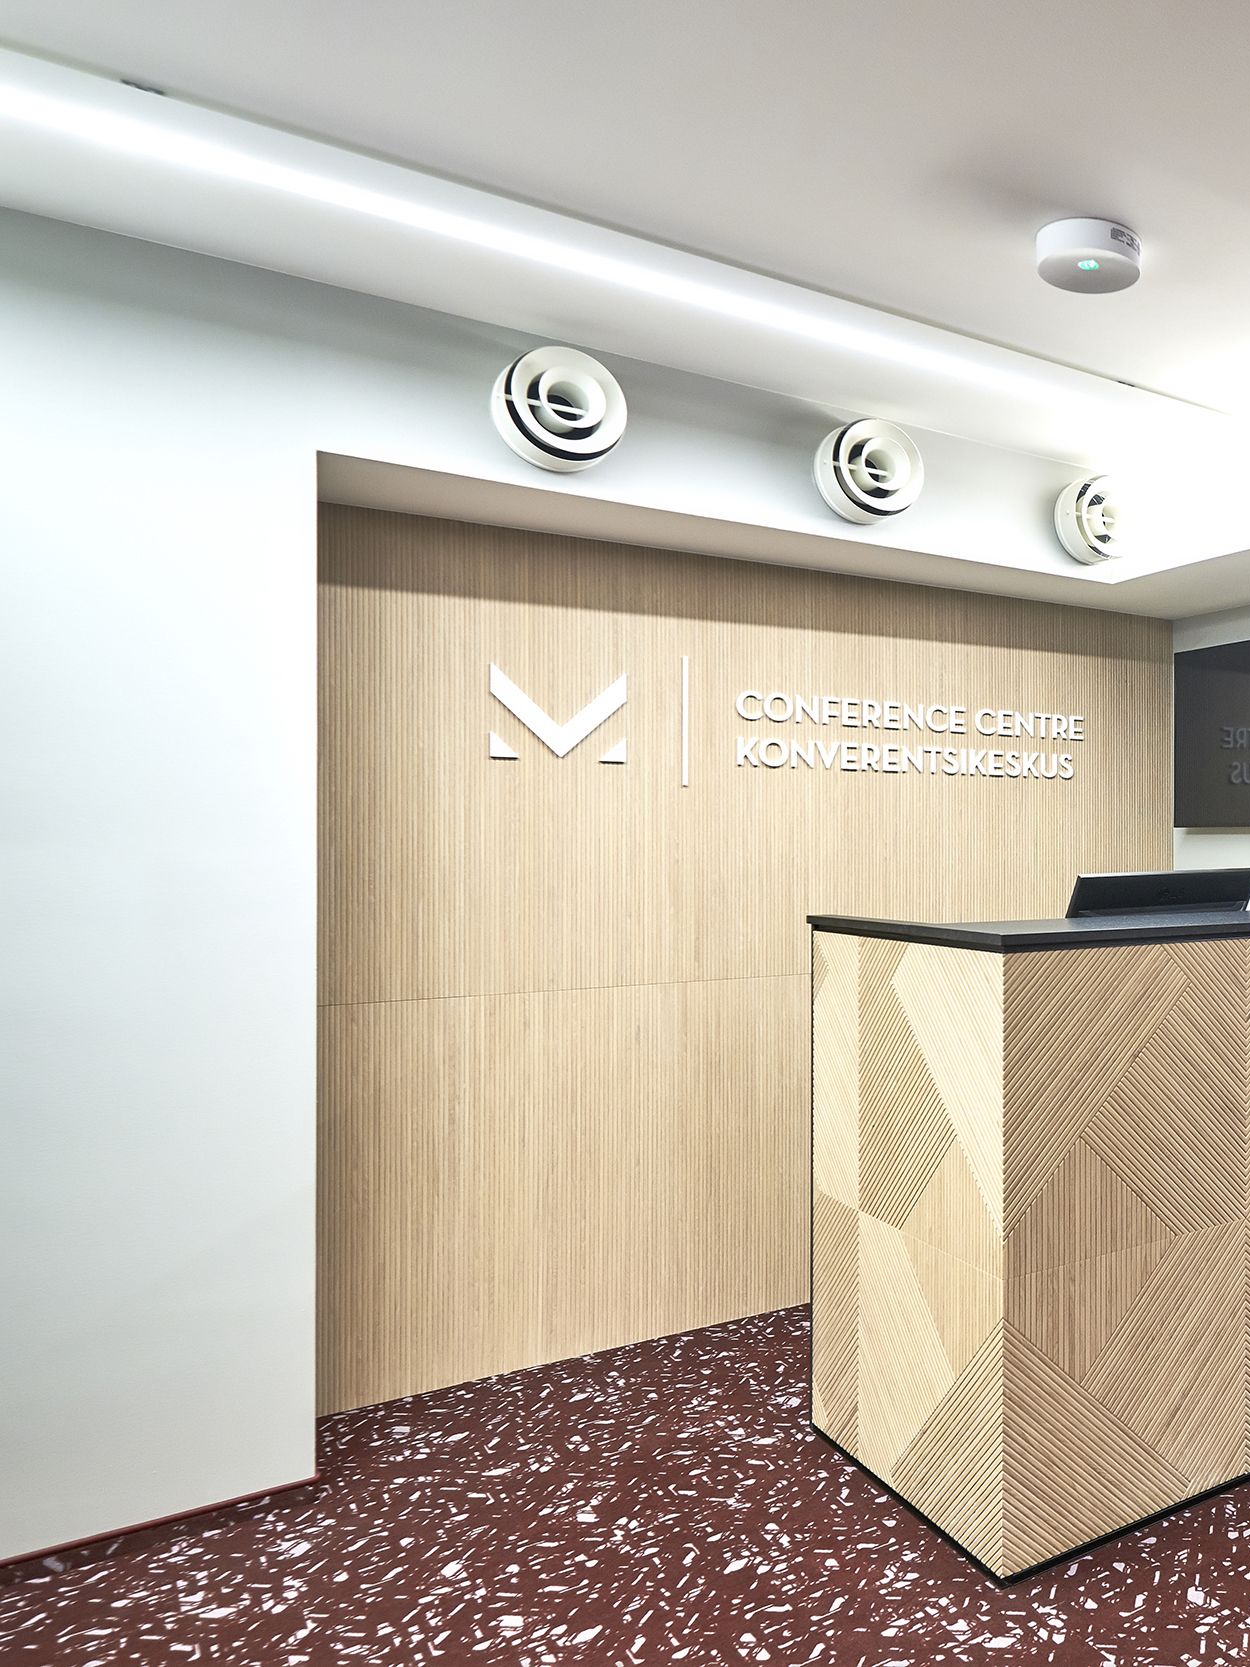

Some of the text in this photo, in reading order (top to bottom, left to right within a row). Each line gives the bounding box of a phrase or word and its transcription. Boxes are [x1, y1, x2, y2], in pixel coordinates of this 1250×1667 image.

[735, 690, 1085, 741] CONFERENCE CENTRE
[735, 736, 1075, 780] KONVERENTSIKESKUS
